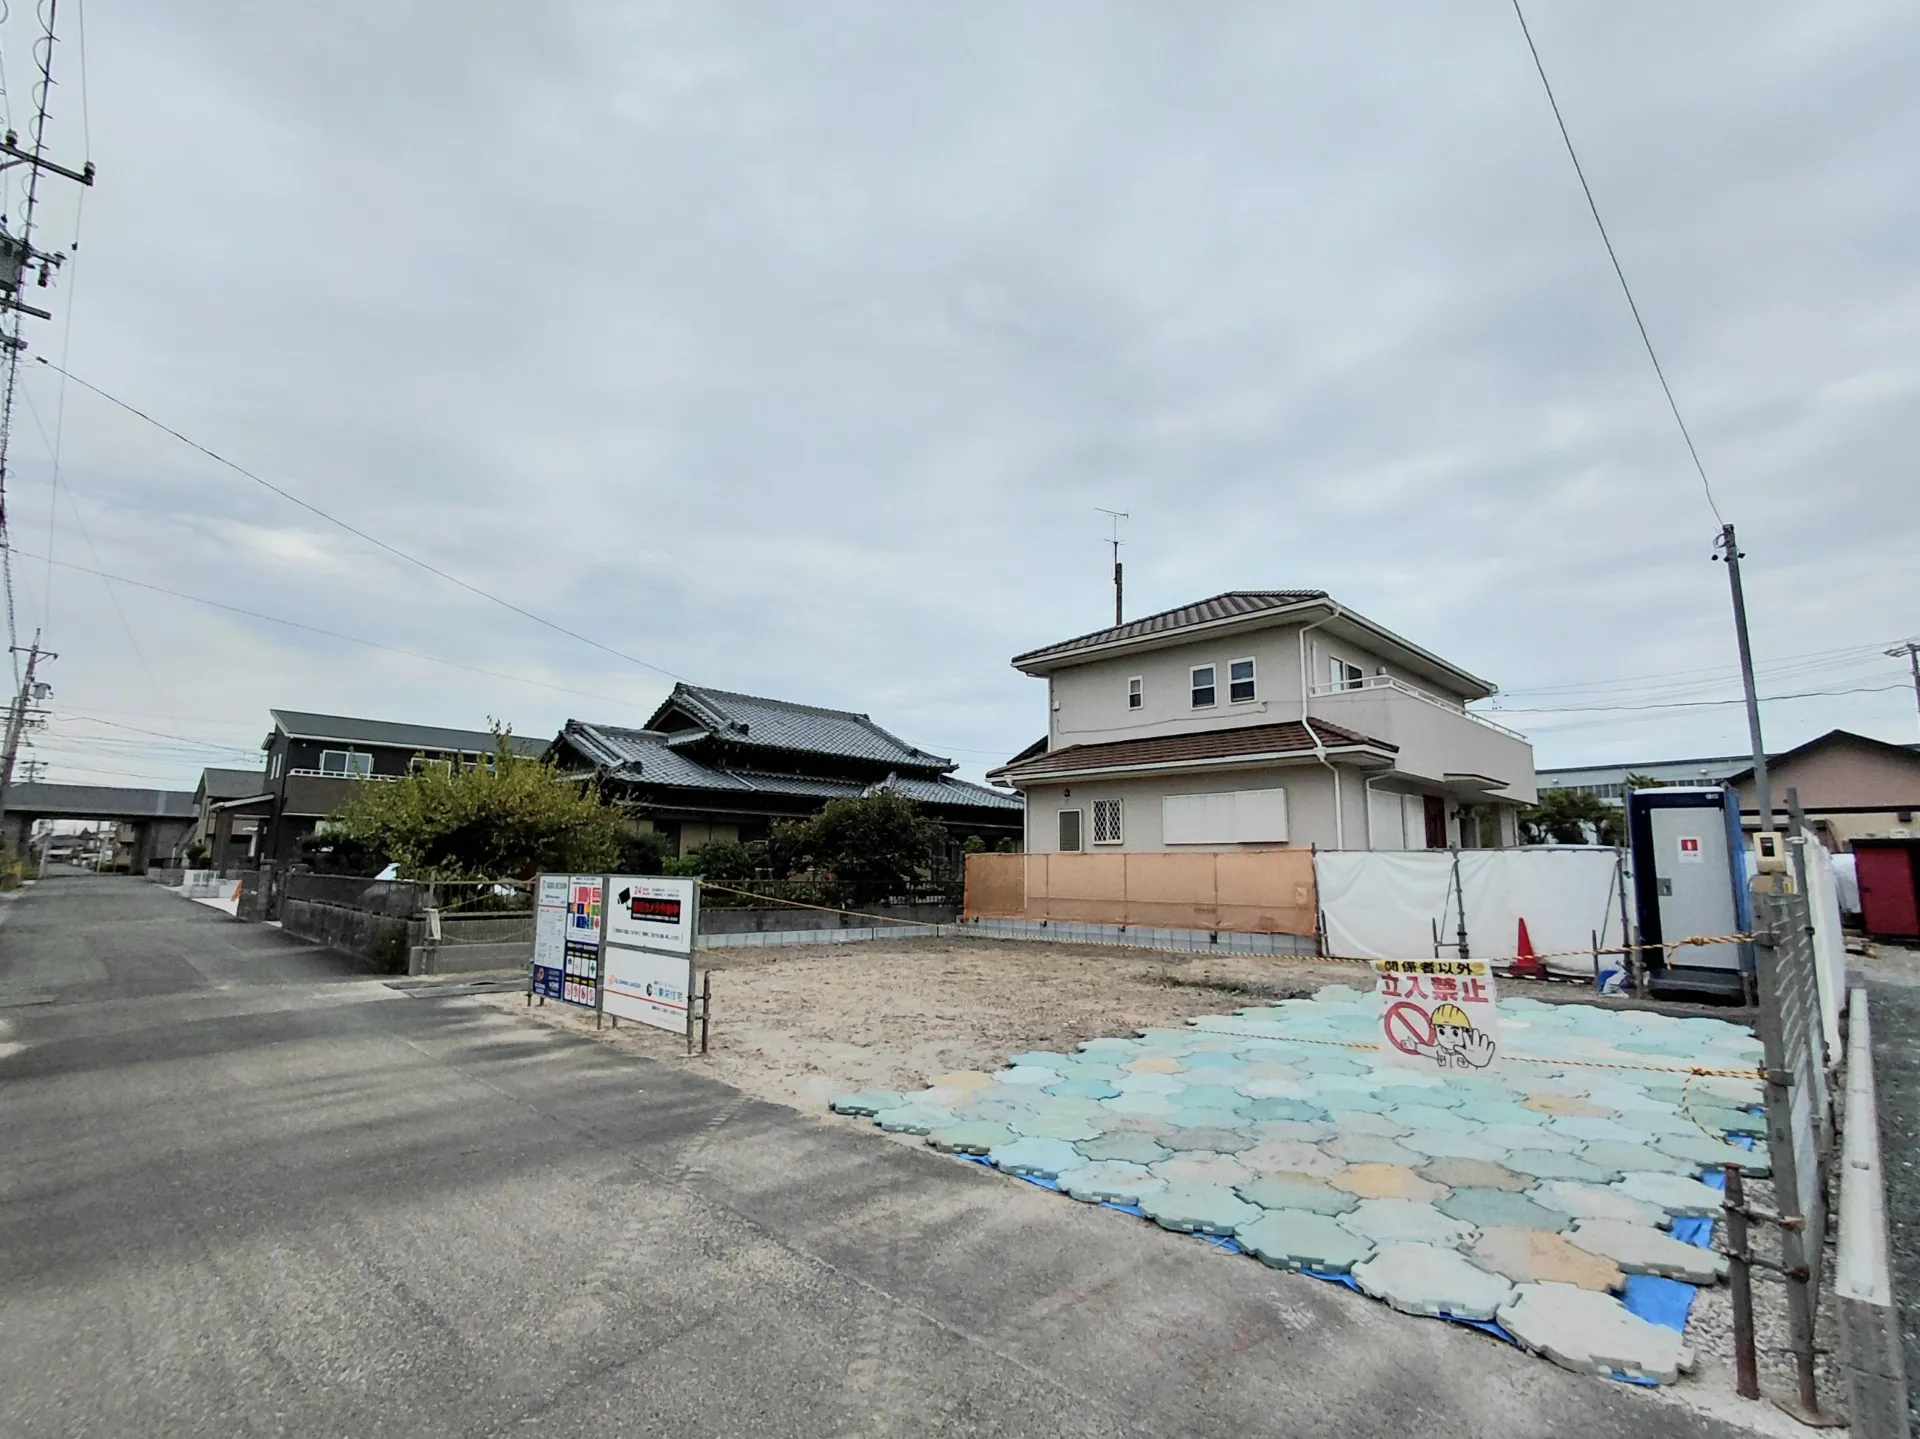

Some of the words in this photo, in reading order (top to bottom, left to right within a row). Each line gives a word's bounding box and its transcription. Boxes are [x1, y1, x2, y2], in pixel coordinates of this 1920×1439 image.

[1384, 961, 1472, 975] 関係者以外
[1381, 974, 1489, 1003] 立入禁止
